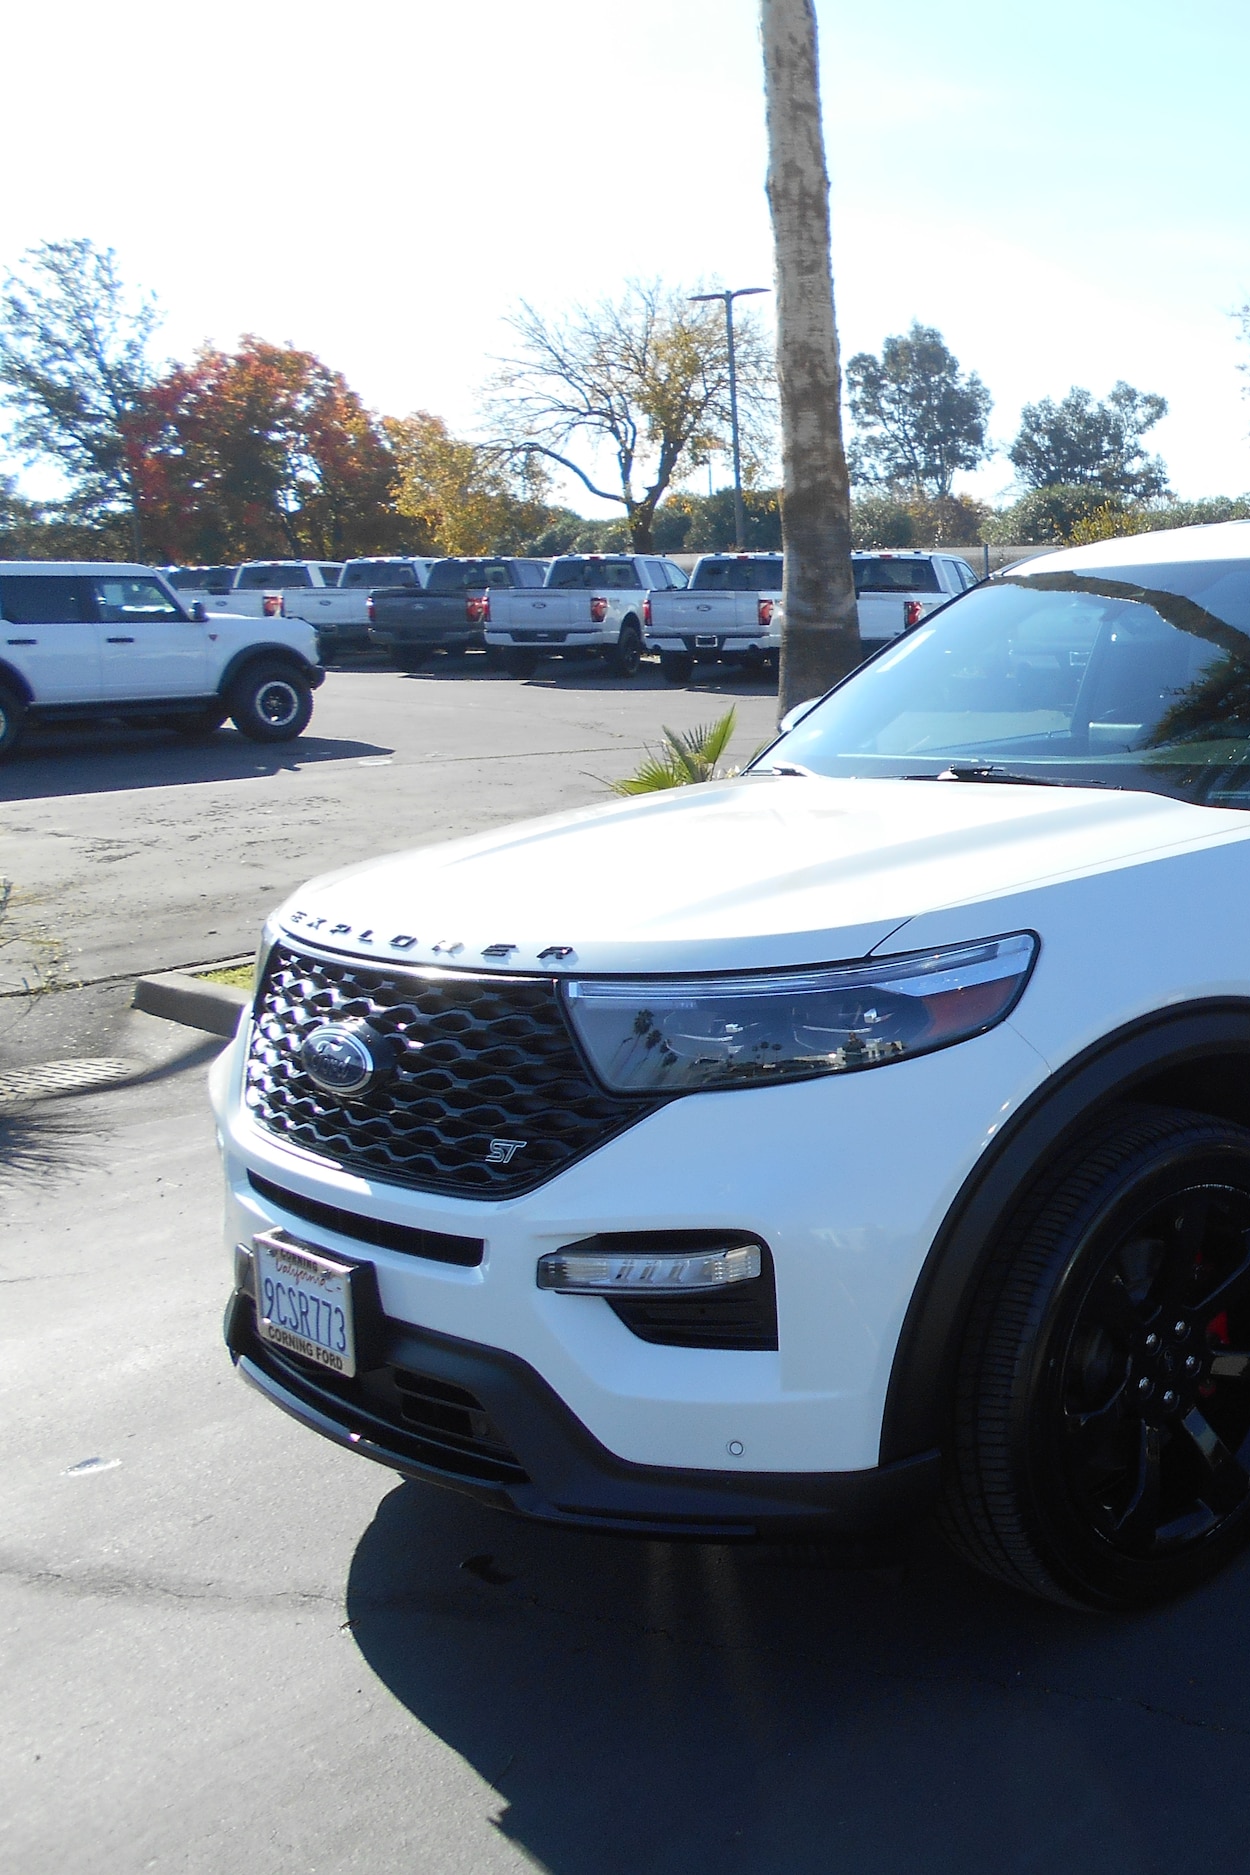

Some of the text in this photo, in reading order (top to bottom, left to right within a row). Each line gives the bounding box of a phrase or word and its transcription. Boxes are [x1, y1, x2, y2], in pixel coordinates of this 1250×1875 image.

[485, 1138, 527, 1164] ST
[264, 1277, 346, 1352] 9CSR773
[268, 1325, 343, 1371] CORNING FORD
